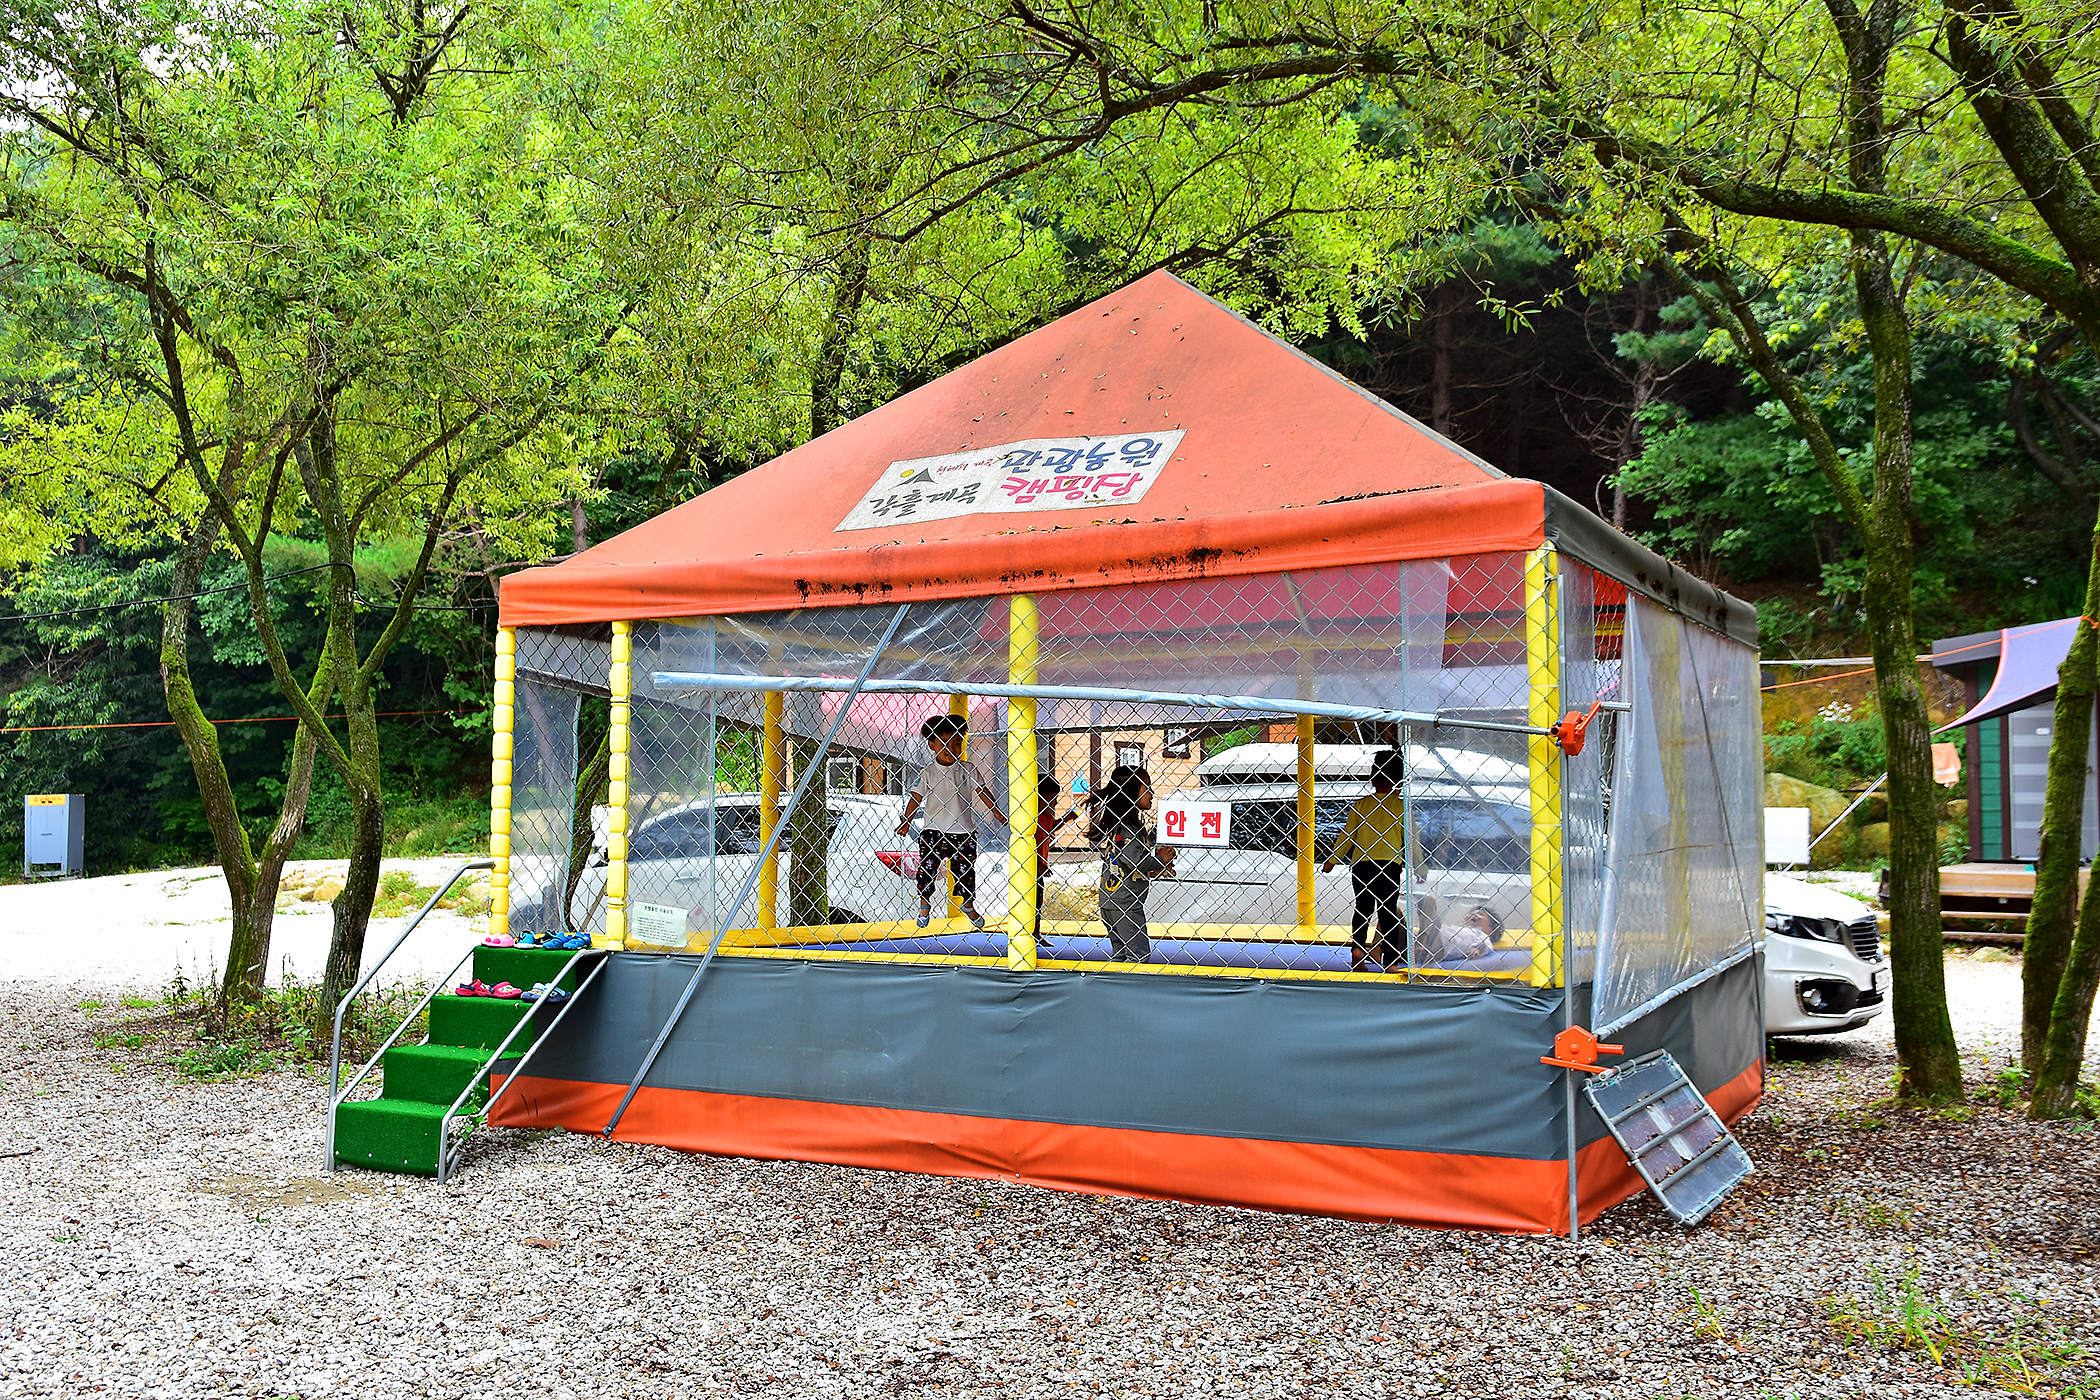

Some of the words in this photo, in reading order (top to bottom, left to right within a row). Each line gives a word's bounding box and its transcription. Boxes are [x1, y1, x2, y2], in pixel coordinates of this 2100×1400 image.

[1001, 438, 1164, 474] 관광농원
[869, 482, 982, 519] 각흘계곡
[1001, 472, 1144, 504] 캠핑장
